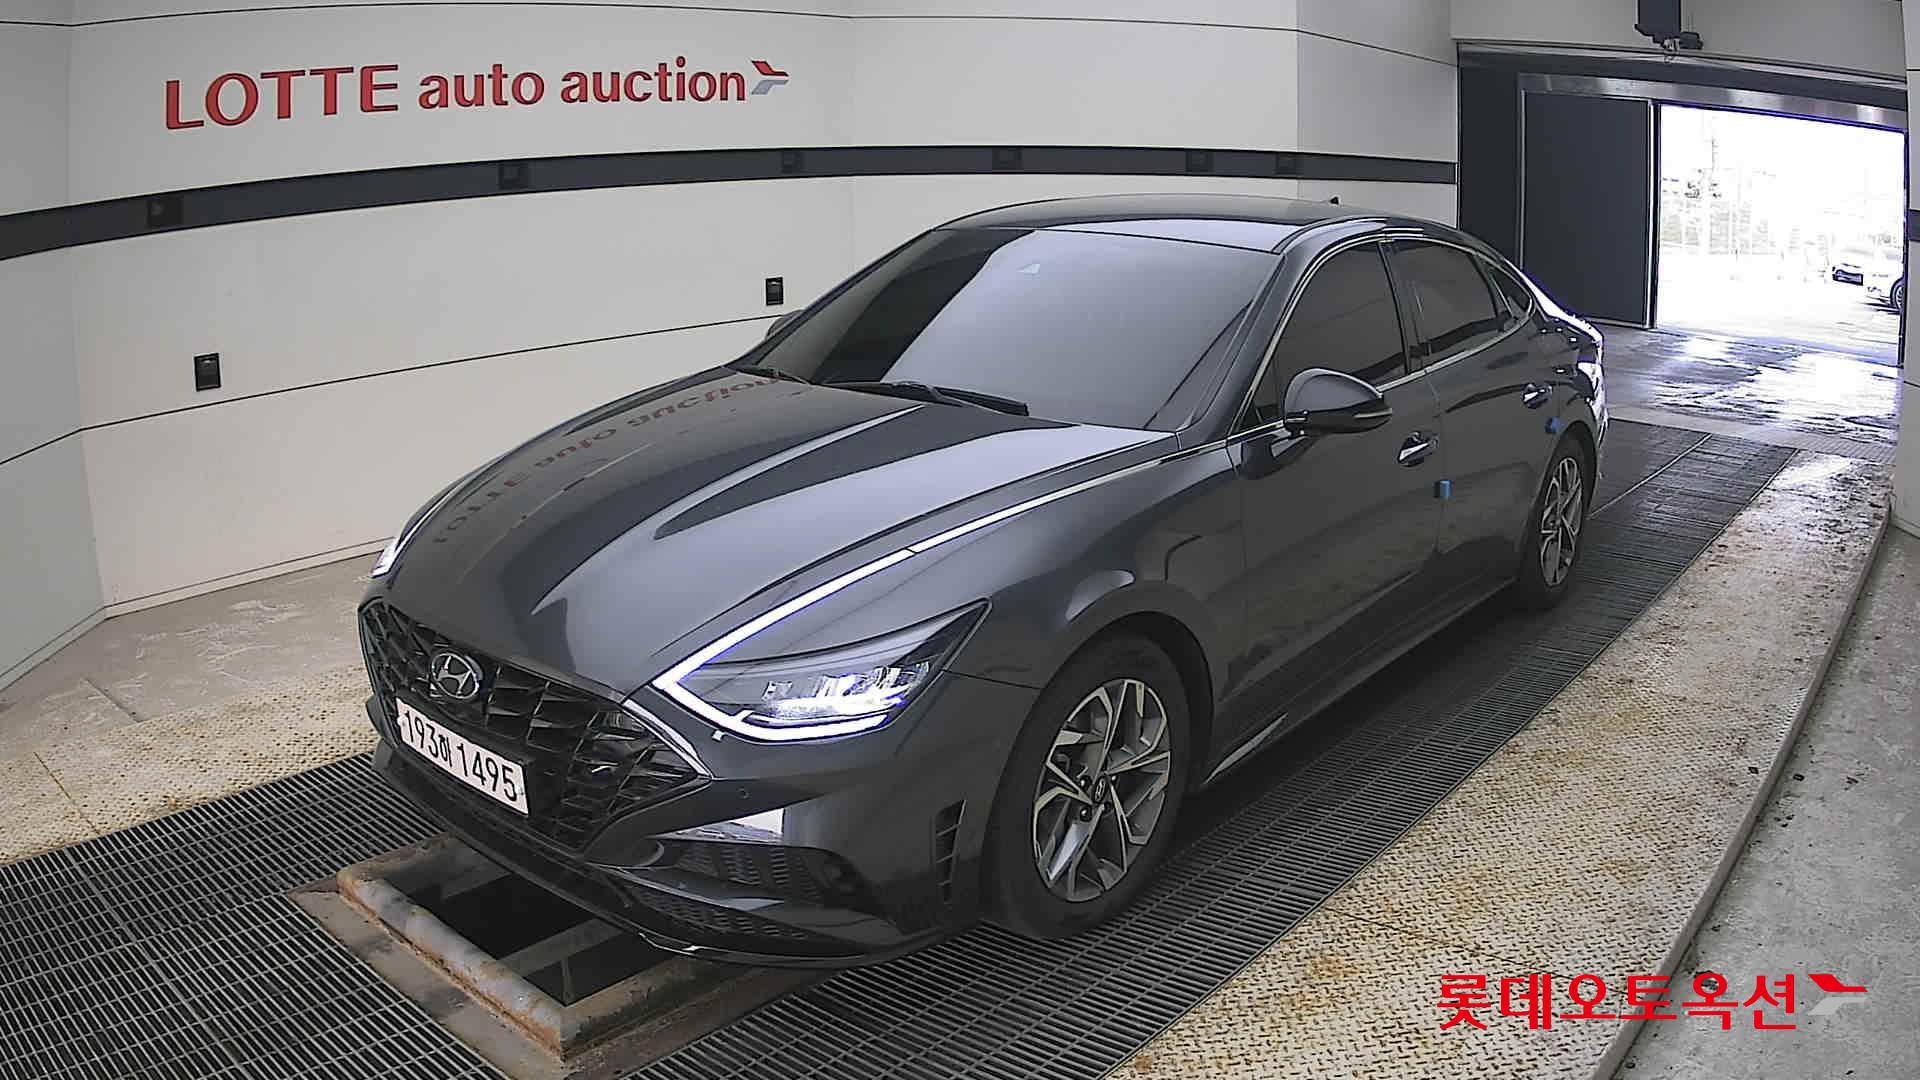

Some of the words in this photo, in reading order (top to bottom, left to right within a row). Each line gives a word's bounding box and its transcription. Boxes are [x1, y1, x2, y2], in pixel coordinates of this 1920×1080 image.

[165, 64, 399, 130] LOTTE
[418, 64, 545, 109] auto
[560, 56, 746, 103] auction
[457, 743, 517, 801] 1495
